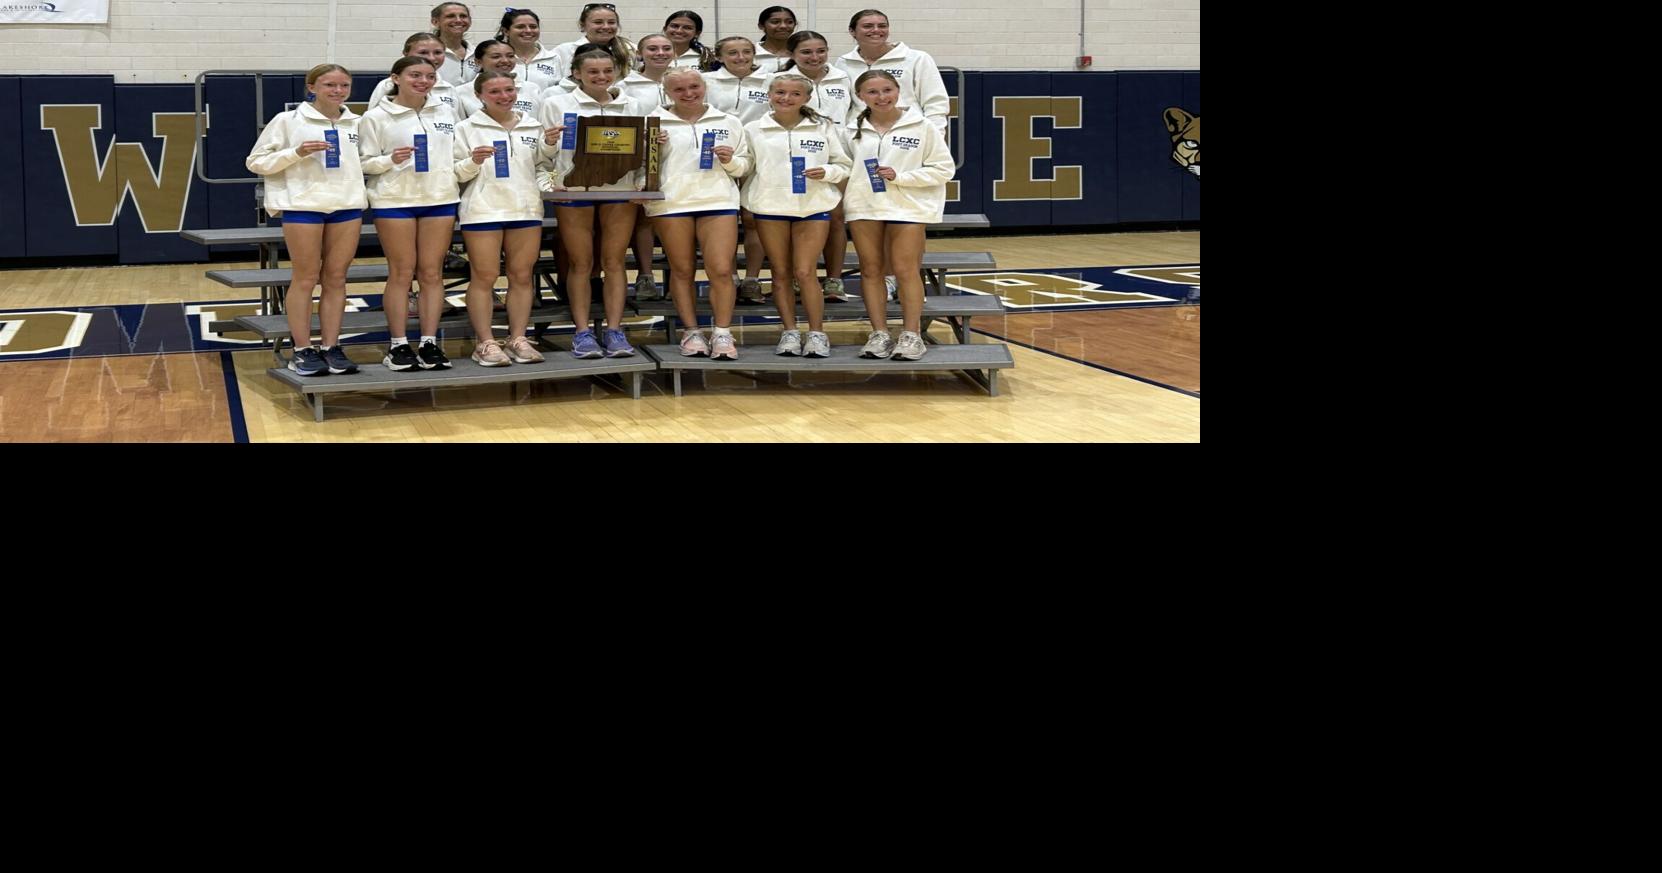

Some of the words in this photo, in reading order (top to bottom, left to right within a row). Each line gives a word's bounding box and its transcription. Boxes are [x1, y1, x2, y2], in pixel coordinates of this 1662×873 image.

[799, 139, 825, 148] LCXC
[892, 136, 920, 145] LCXC
[650, 128, 658, 172] IHSAA
